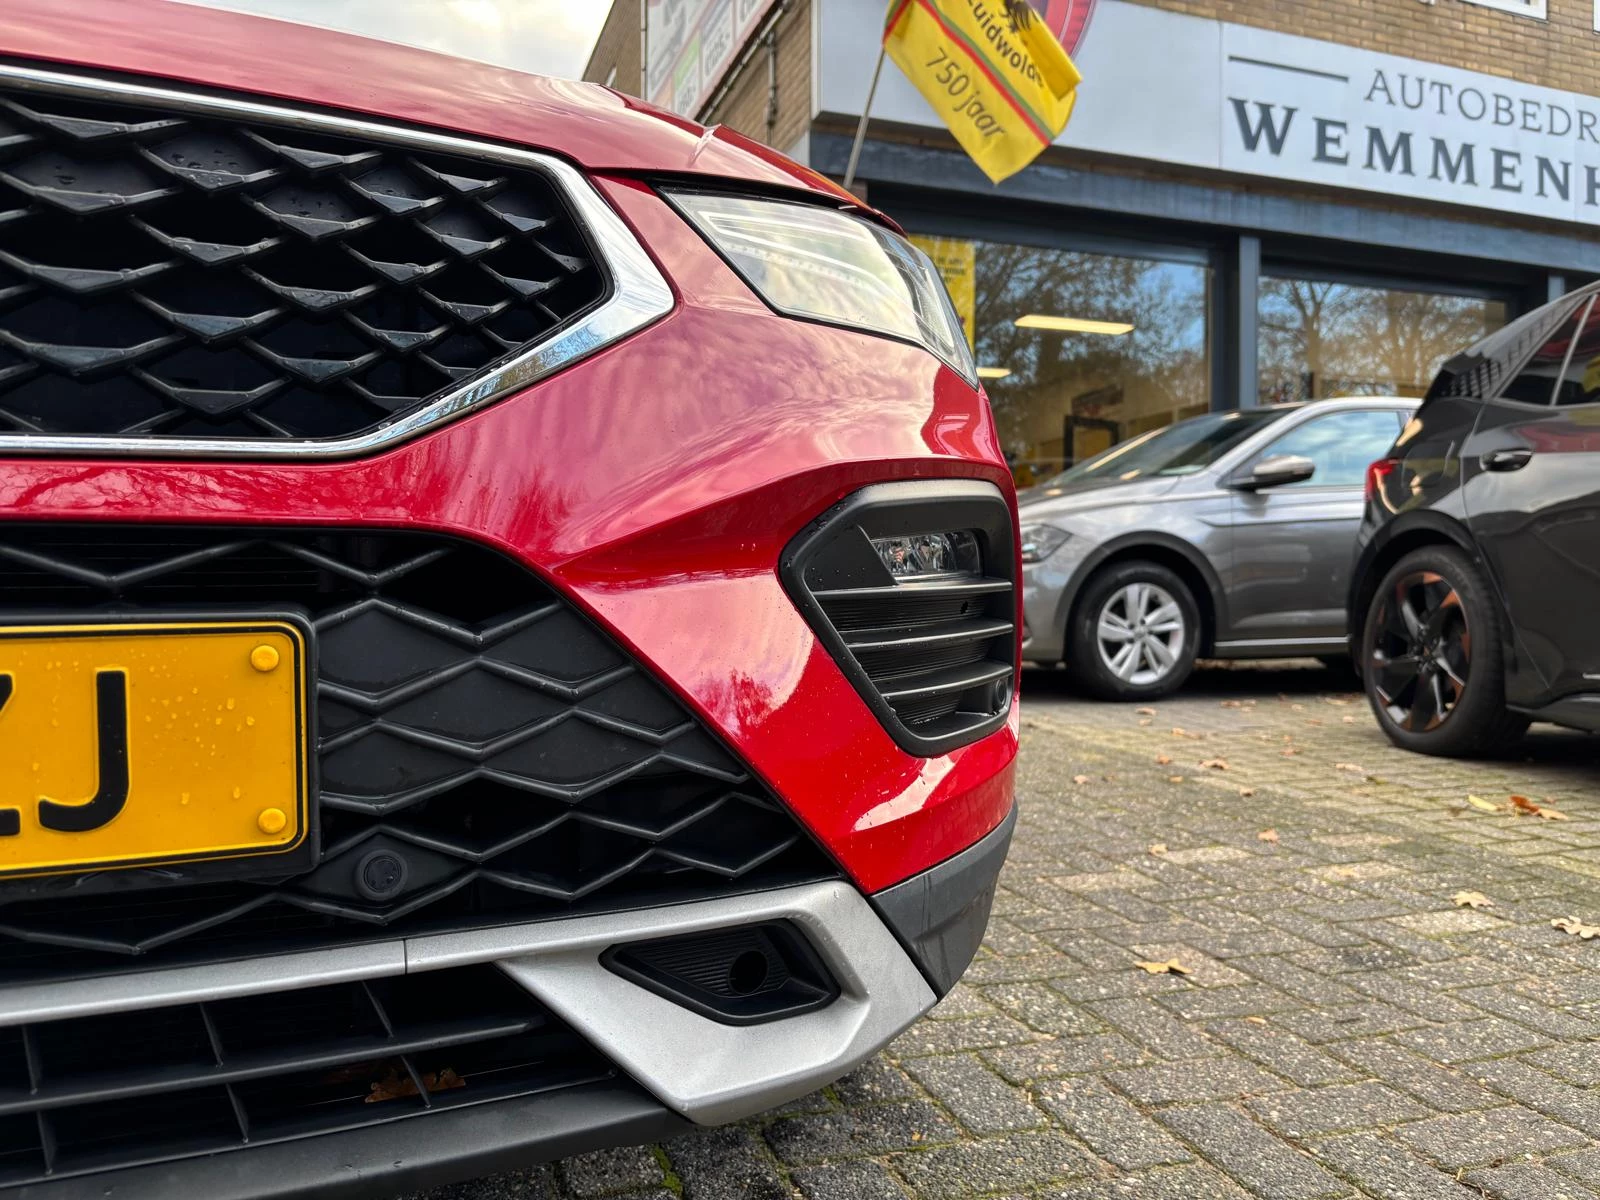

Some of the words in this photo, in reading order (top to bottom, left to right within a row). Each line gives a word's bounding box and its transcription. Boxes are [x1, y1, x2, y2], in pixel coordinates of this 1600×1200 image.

[926, 47, 969, 97] 750
[952, 90, 1006, 138] jaar
[1364, 69, 1600, 144] AUTOBEDR
[0, 671, 130, 836] J
